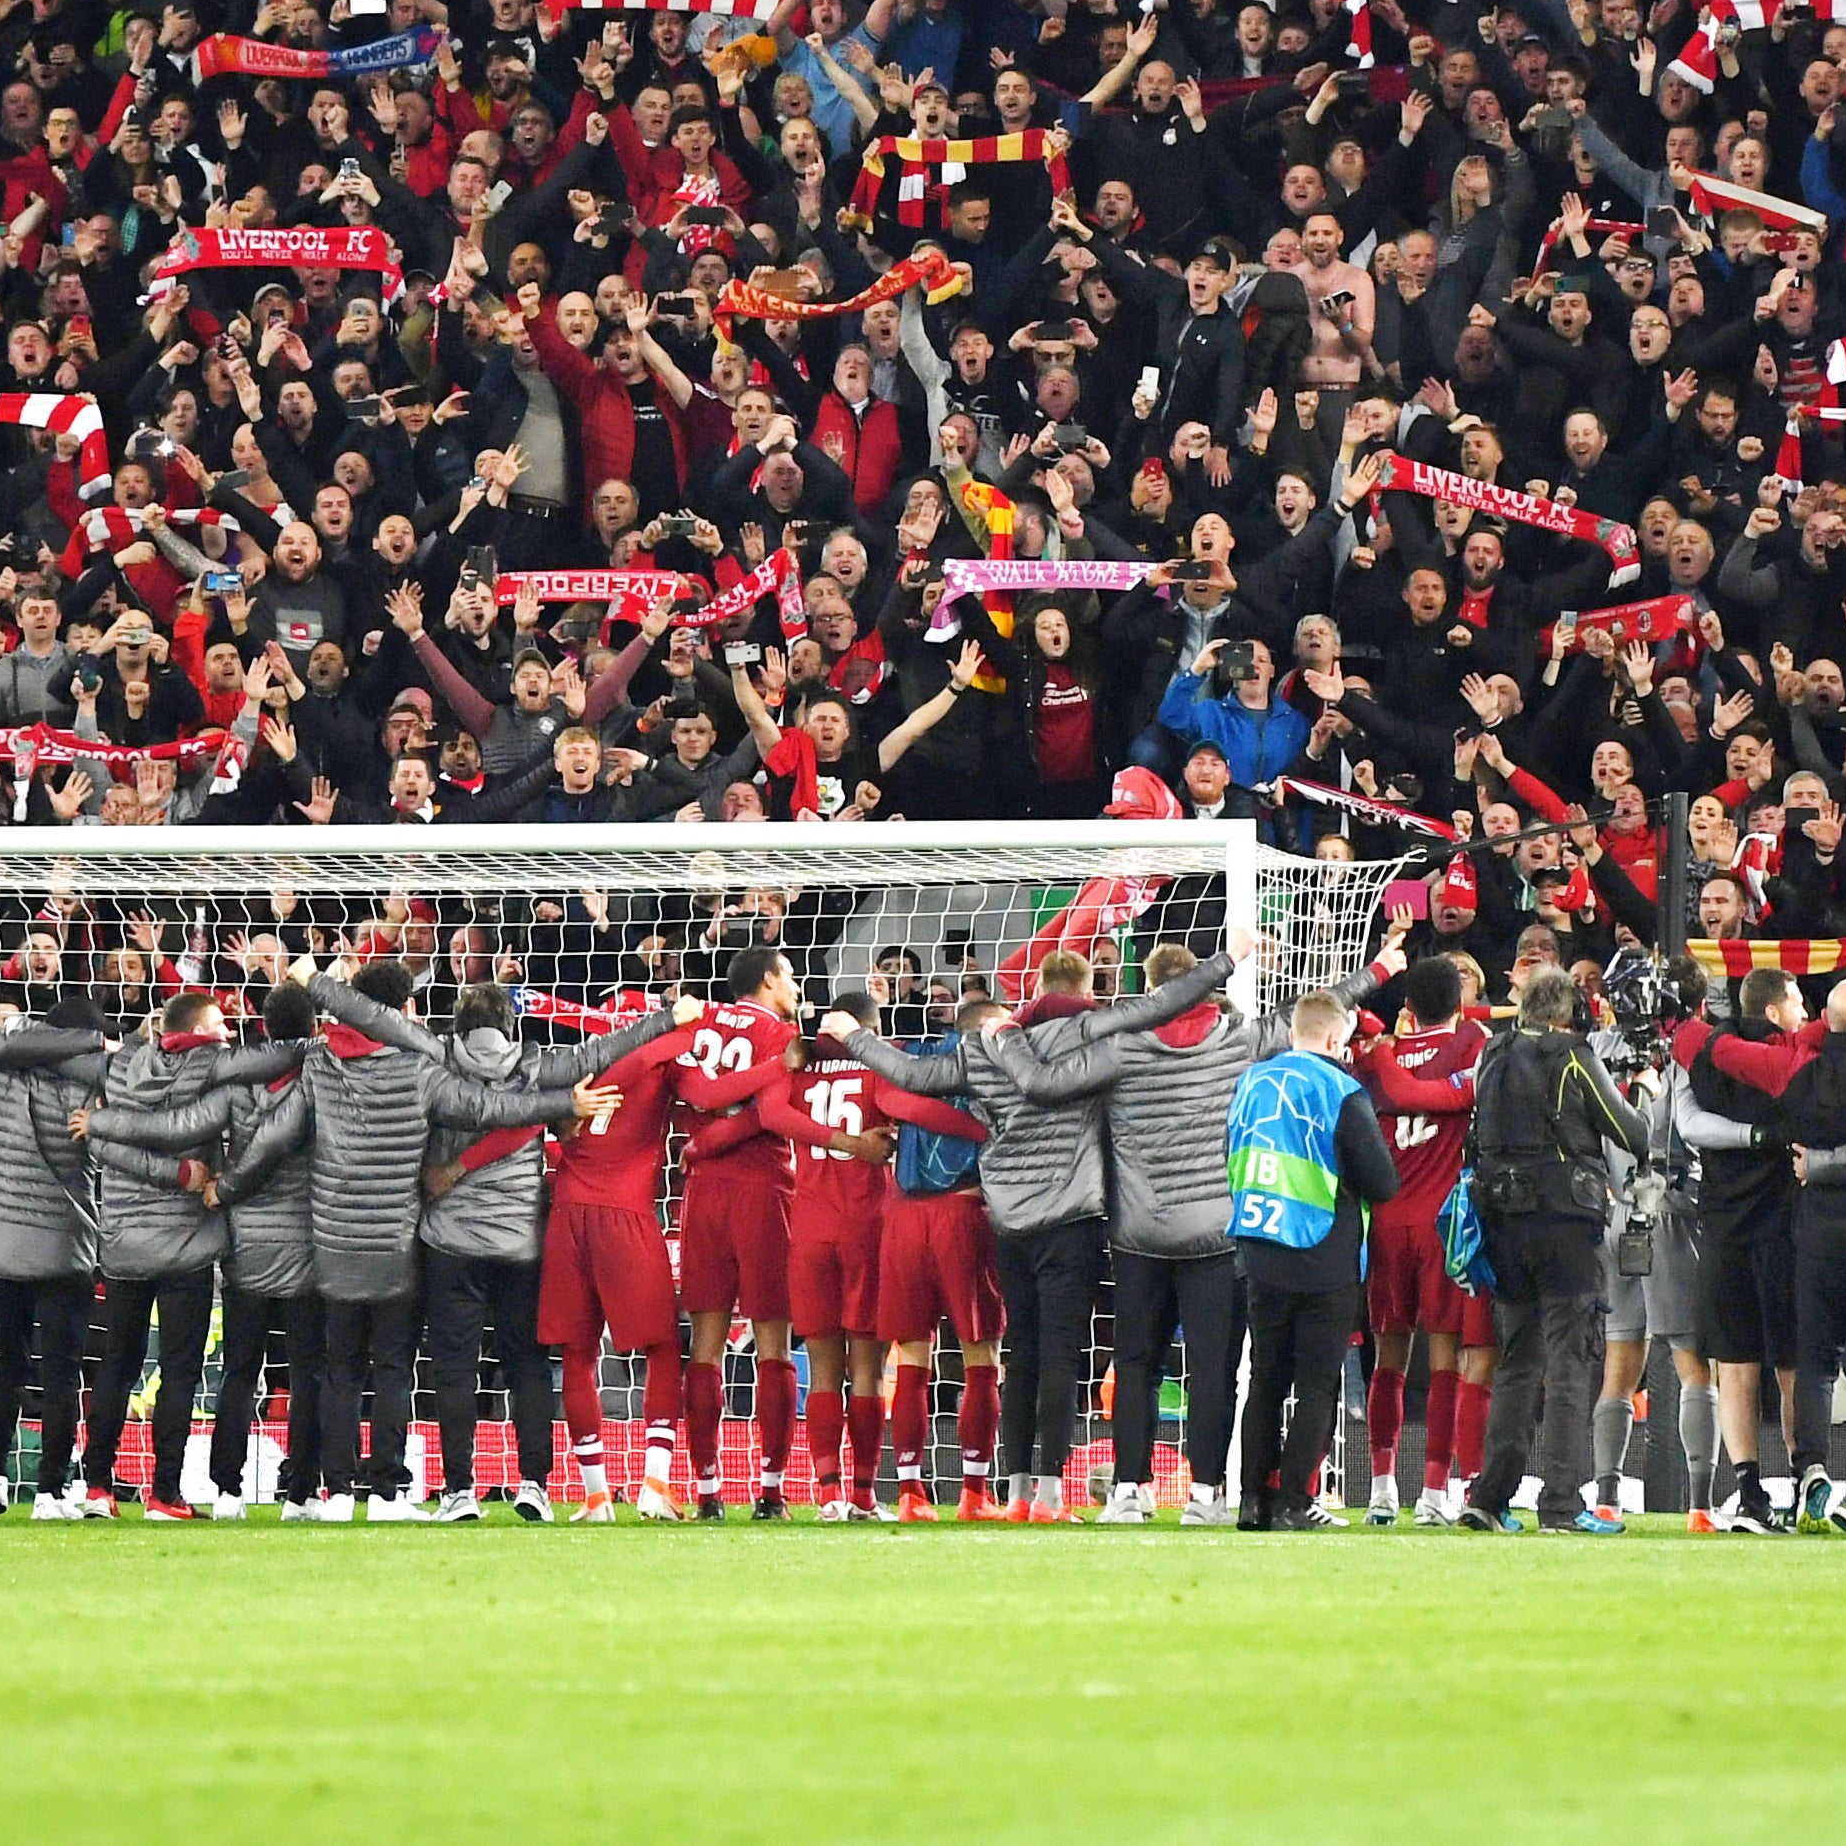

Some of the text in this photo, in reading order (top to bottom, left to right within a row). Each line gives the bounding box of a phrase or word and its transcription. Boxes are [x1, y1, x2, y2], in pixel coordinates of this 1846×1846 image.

[216, 228, 373, 253] LIVERPOOL FC
[1412, 461, 1578, 524] LIVERPOOL FC
[1414, 481, 1575, 534] YOU'LL NEVER WALK ALONE
[976, 560, 1120, 574] YOU'LL NEVER
[985, 569, 1121, 584] WALK ALONE
[1041, 695, 1083, 706] Chartered
[803, 1077, 864, 1162] 15
[1239, 1194, 1284, 1235] 52
